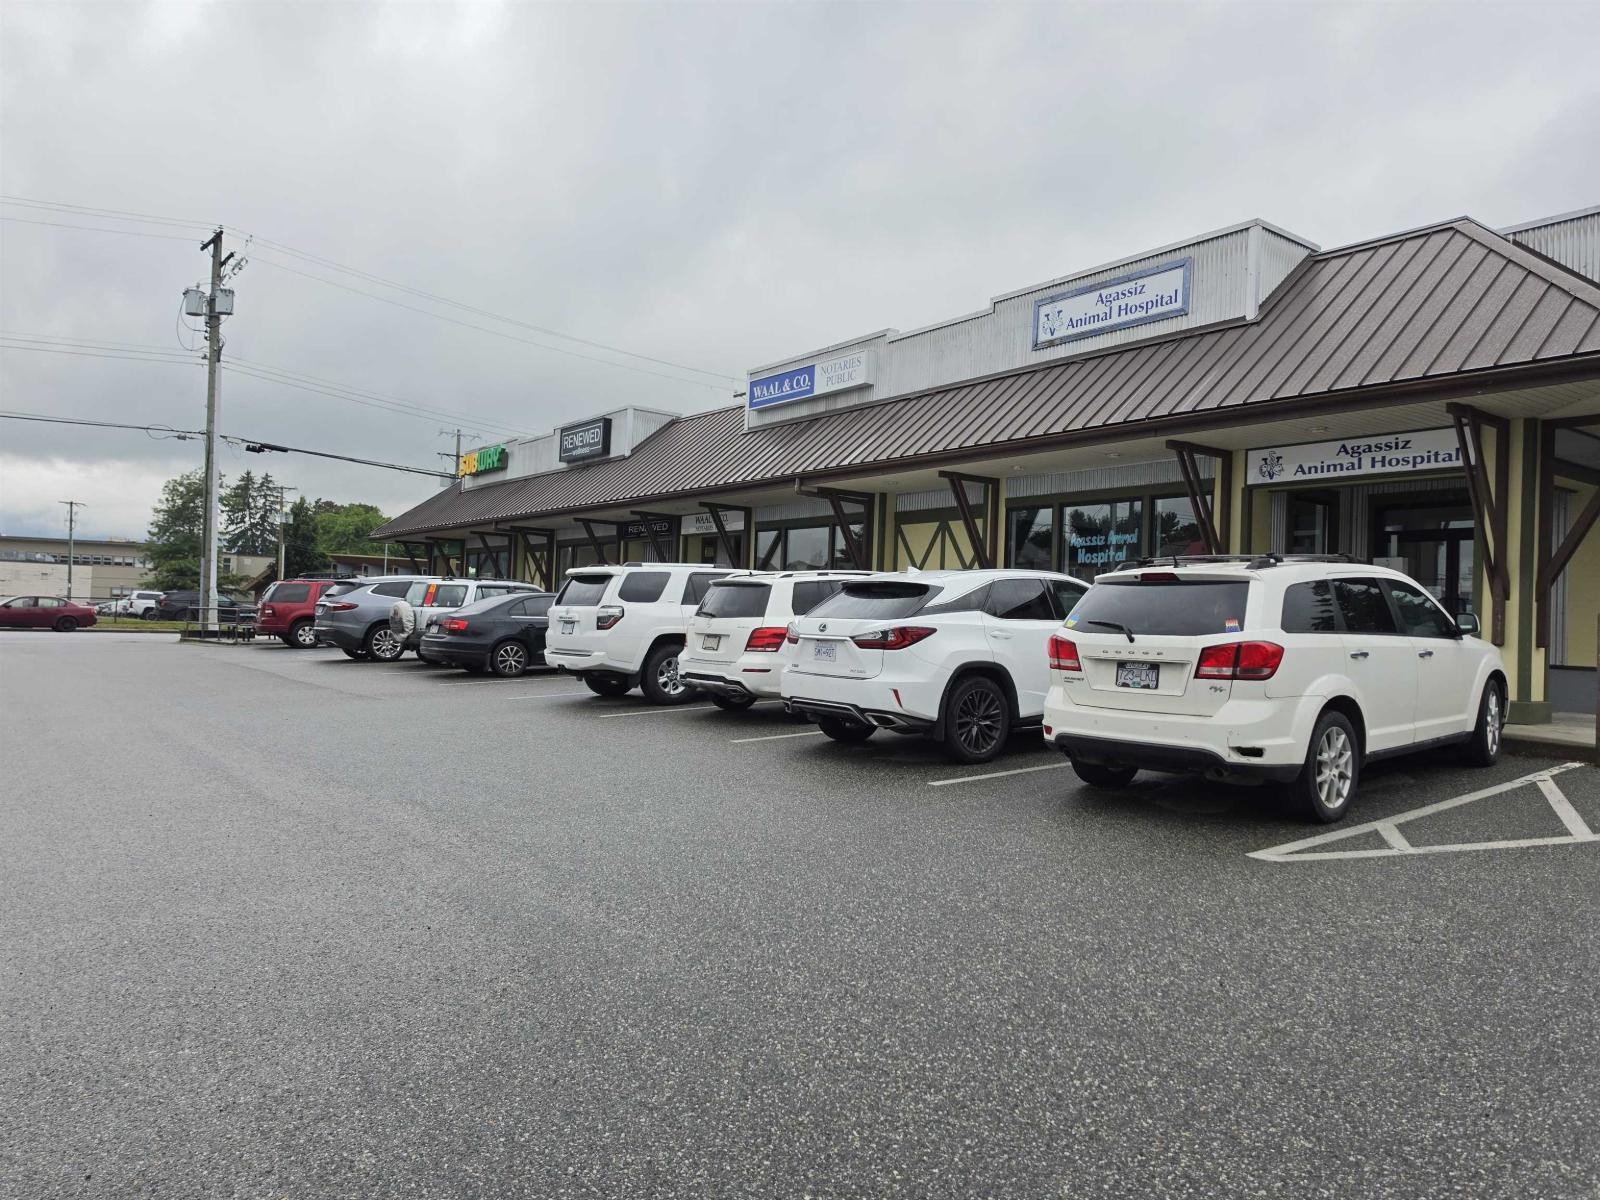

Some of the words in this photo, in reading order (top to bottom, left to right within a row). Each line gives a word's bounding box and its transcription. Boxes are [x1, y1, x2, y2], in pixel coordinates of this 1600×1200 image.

[1095, 282, 1146, 307] Agassiz
[1066, 306, 1112, 330] Animal
[1117, 289, 1178, 317] Hospital
[818, 357, 862, 376] NOTARIES
[826, 369, 857, 387] PUBLIC
[753, 381, 782, 399] WAAL
[782, 379, 791, 393] &
[793, 374, 812, 390] CO.
[563, 428, 601, 450] RENEWED
[1336, 437, 1413, 459] Agassiz
[458, 444, 506, 478] SUBWAY
[1294, 458, 1362, 477] Animal
[1370, 447, 1461, 470] Hospital
[1107, 527, 1138, 545] Animal
[1078, 545, 1127, 568] Hospital
